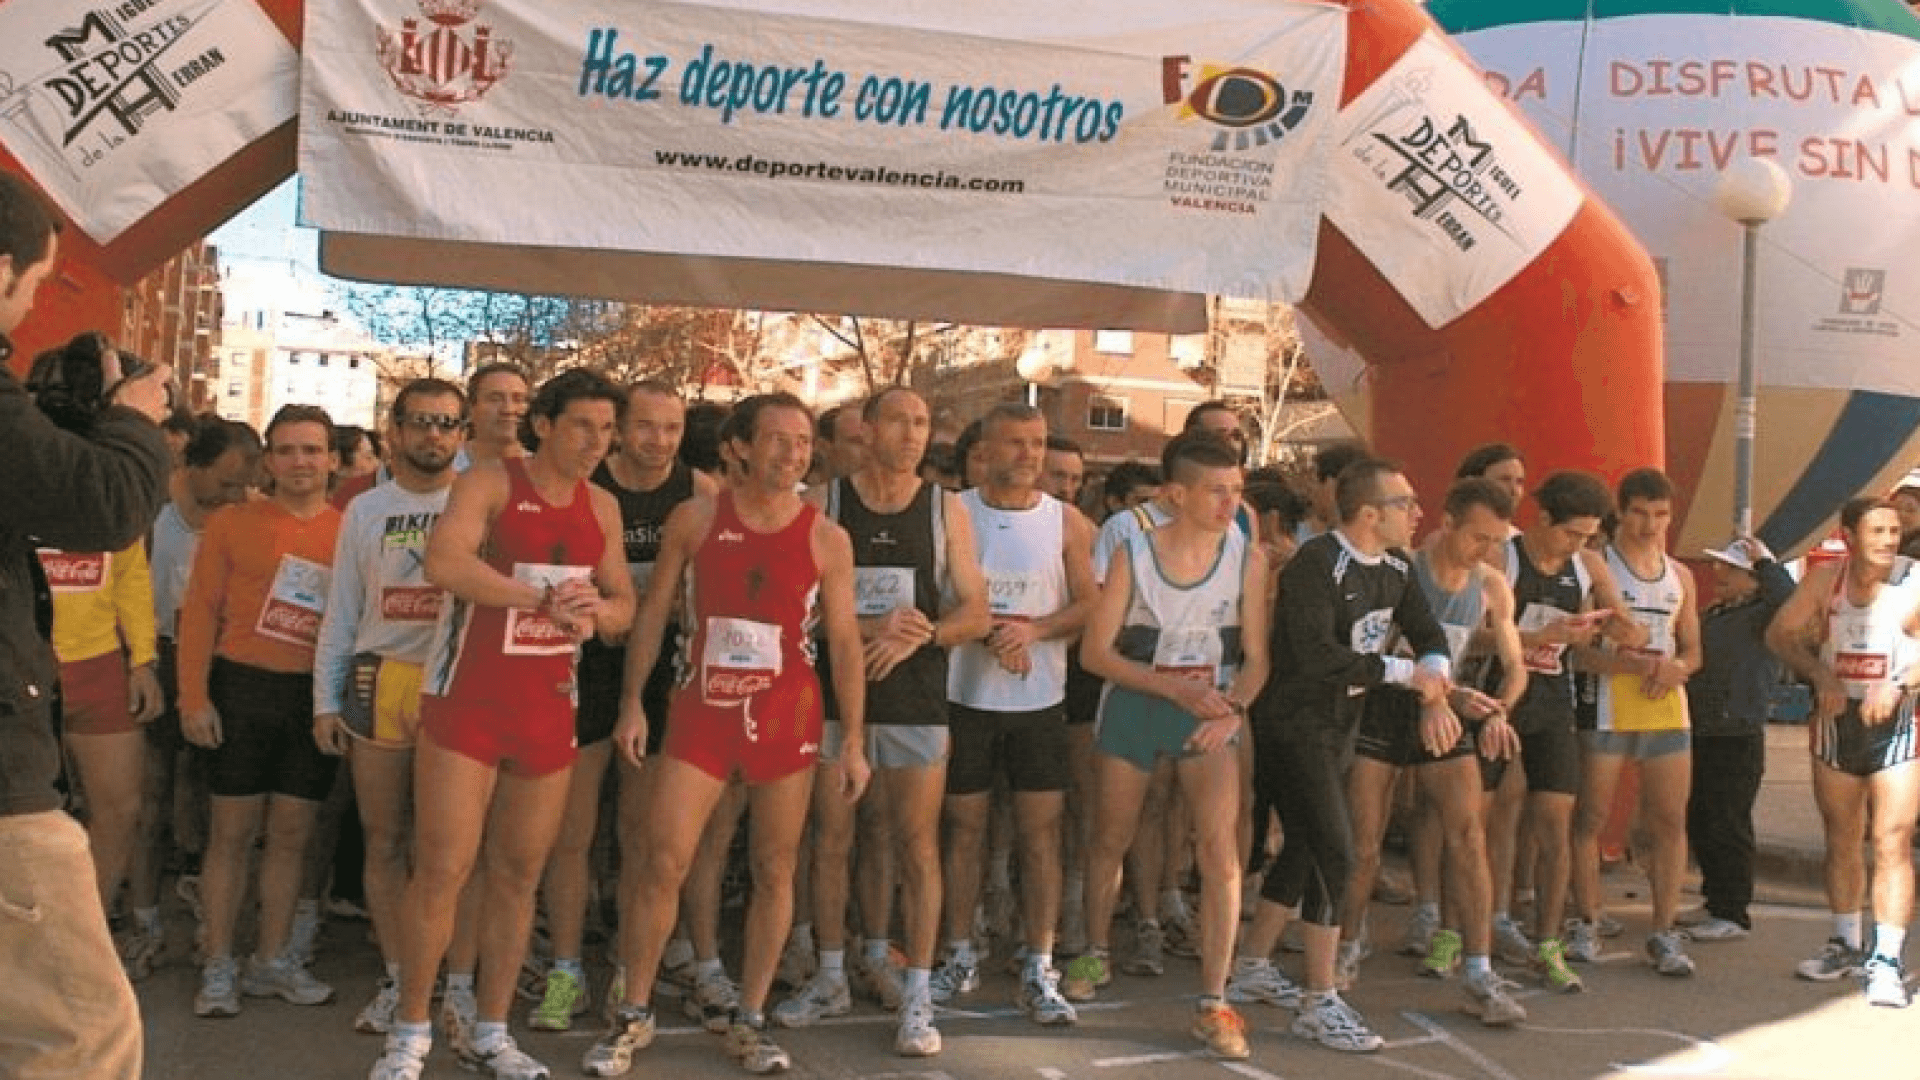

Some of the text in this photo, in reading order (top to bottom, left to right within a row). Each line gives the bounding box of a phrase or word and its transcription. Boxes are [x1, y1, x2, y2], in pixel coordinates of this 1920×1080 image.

[578, 27, 1124, 143] Haz deporte con nosotros
[1610, 60, 1881, 109] DISFRUTA
[327, 108, 438, 134] AJUNTAMENT
[443, 121, 468, 138] DE
[473, 124, 555, 144] VALENCIA
[654, 150, 1025, 193] www.deportevalencia.com
[1164, 165, 1273, 188] DEPORTIVA
[1168, 151, 1275, 174] FUNDACION
[1799, 136, 1889, 183] SIN
[1163, 179, 1269, 202] MUNICIPAL
[1168, 195, 1257, 214] VALENCIA
